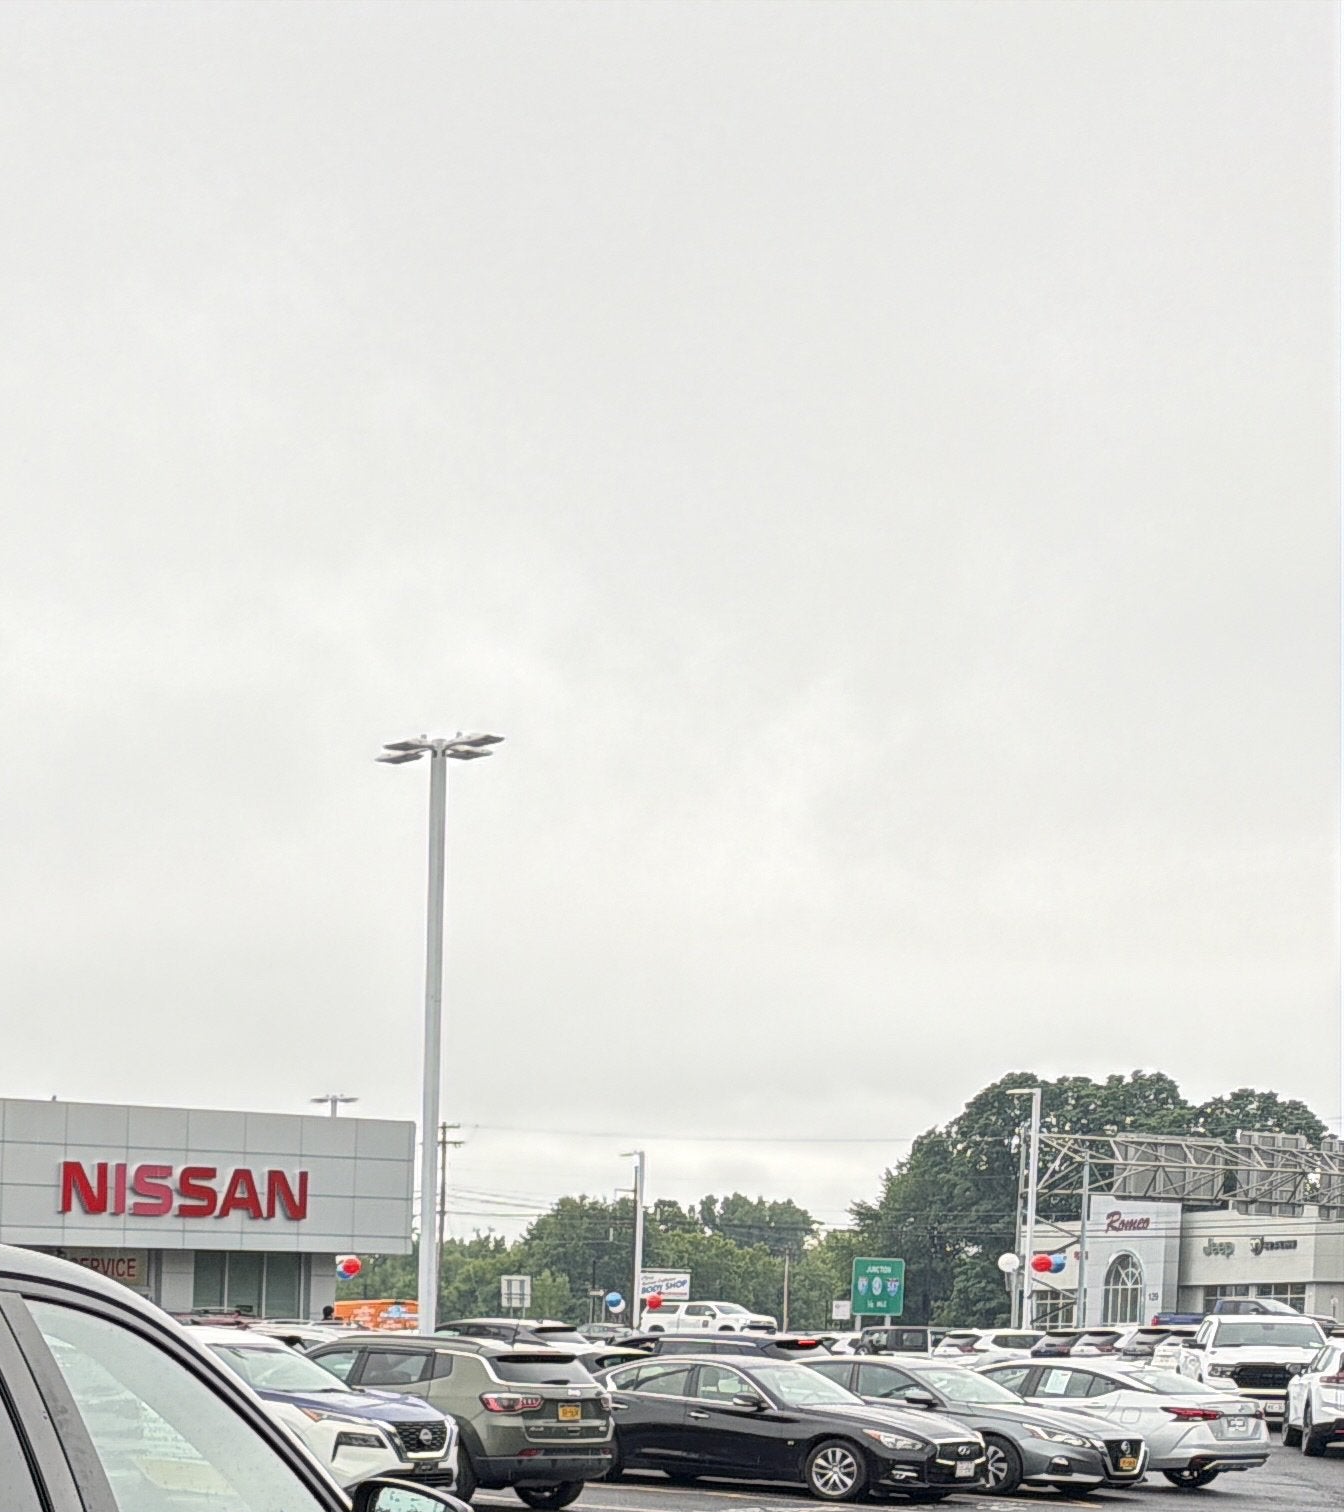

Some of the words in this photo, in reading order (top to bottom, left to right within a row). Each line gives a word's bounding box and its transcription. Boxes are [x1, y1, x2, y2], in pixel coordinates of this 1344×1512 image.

[59, 1161, 308, 1220] NISSAN
[1105, 1211, 1150, 1233] Romeo
[1203, 1238, 1235, 1259] Jeep
